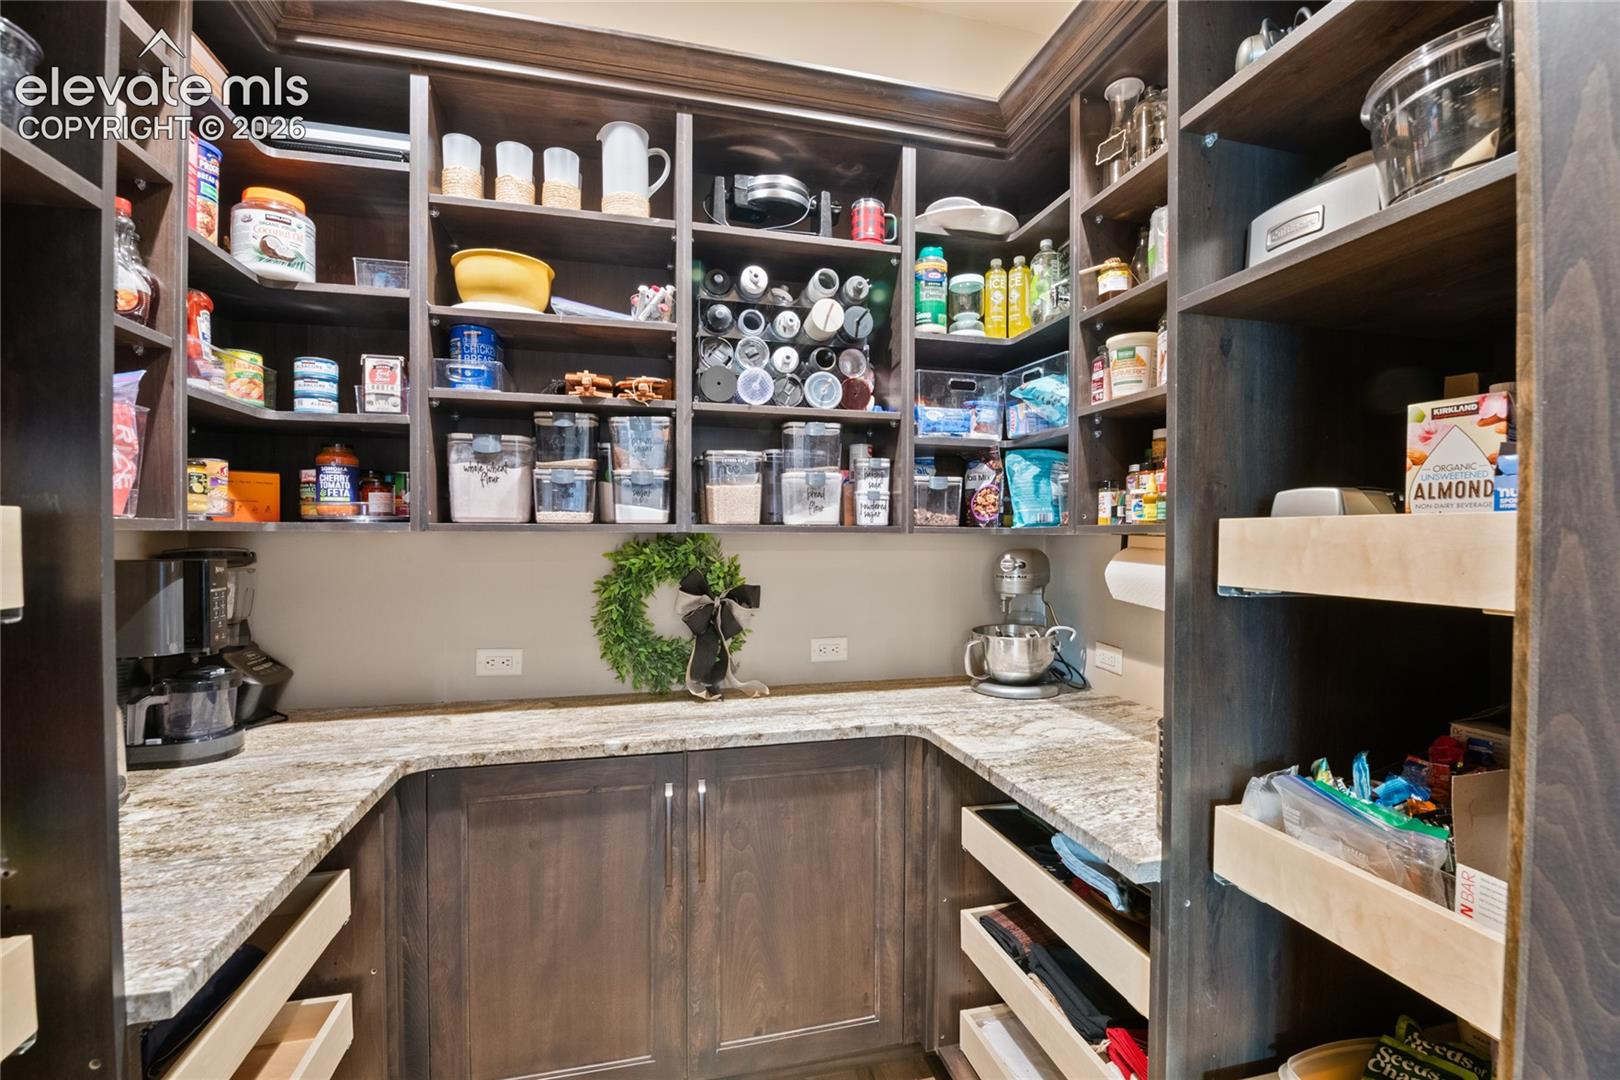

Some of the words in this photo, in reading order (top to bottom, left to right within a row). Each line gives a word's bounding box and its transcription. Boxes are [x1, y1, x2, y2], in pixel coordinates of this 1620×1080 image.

[989, 278, 1007, 289] ICE
[1009, 276, 1022, 288] CE
[463, 343, 496, 356] CHICKE
[1433, 403, 1478, 416] KIRKLAND
[463, 460, 484, 473] whole
[487, 461, 509, 474] wheat
[1433, 463, 1477, 472] ORGANIC
[319, 473, 350, 483] CHERRY
[480, 473, 500, 488] flour
[1421, 471, 1488, 481] UNSWEETENED
[319, 481, 350, 490] TOMATO
[1414, 480, 1494, 500] ALMOND
[327, 488, 350, 497] FETA
[1461, 870, 1475, 903] BAR
